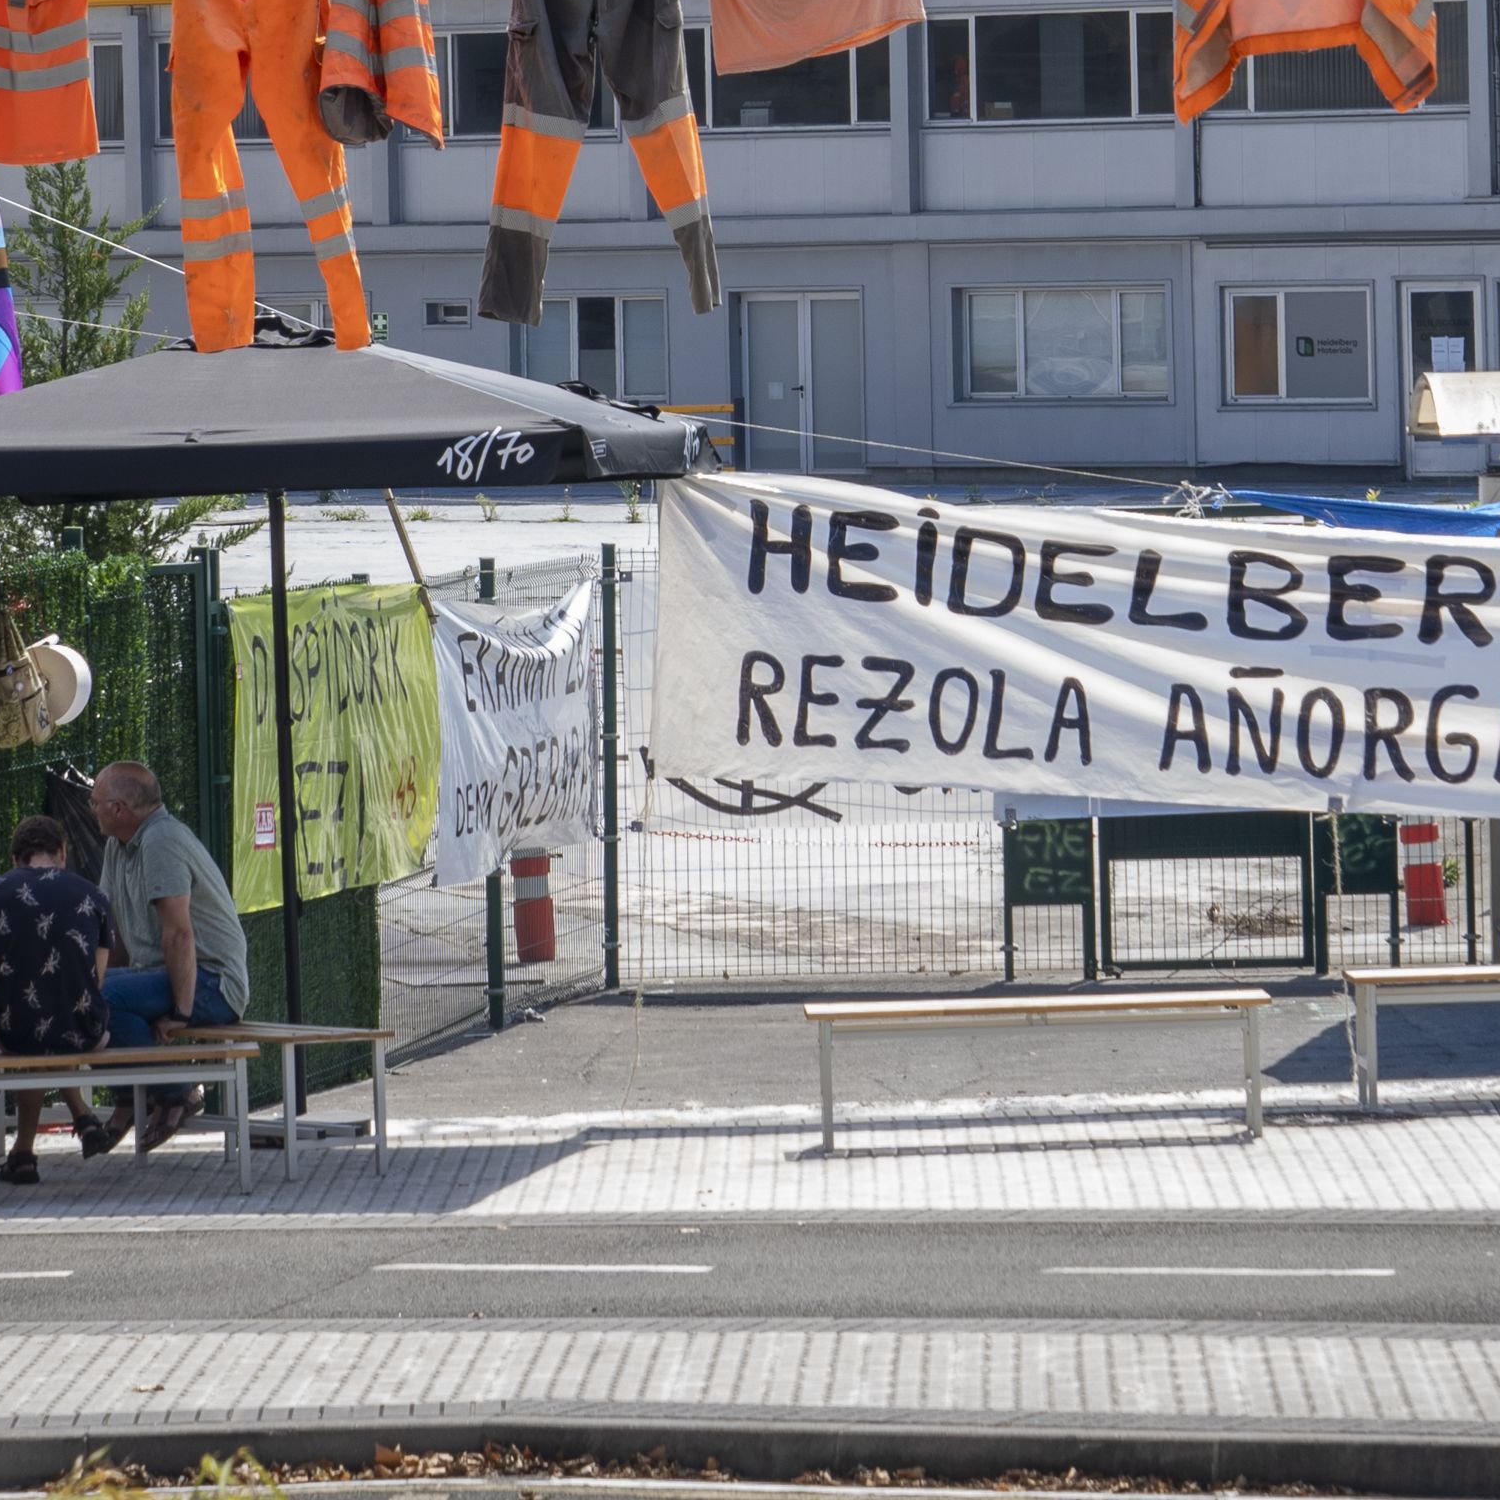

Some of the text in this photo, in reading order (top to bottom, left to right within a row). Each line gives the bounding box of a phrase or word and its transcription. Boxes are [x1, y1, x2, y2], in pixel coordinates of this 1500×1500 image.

[1317, 338, 1358, 347] Heidelberg
[437, 426, 535, 483] 18/70
[736, 650, 1094, 766] REZOLA
[256, 811, 274, 831] LAB
